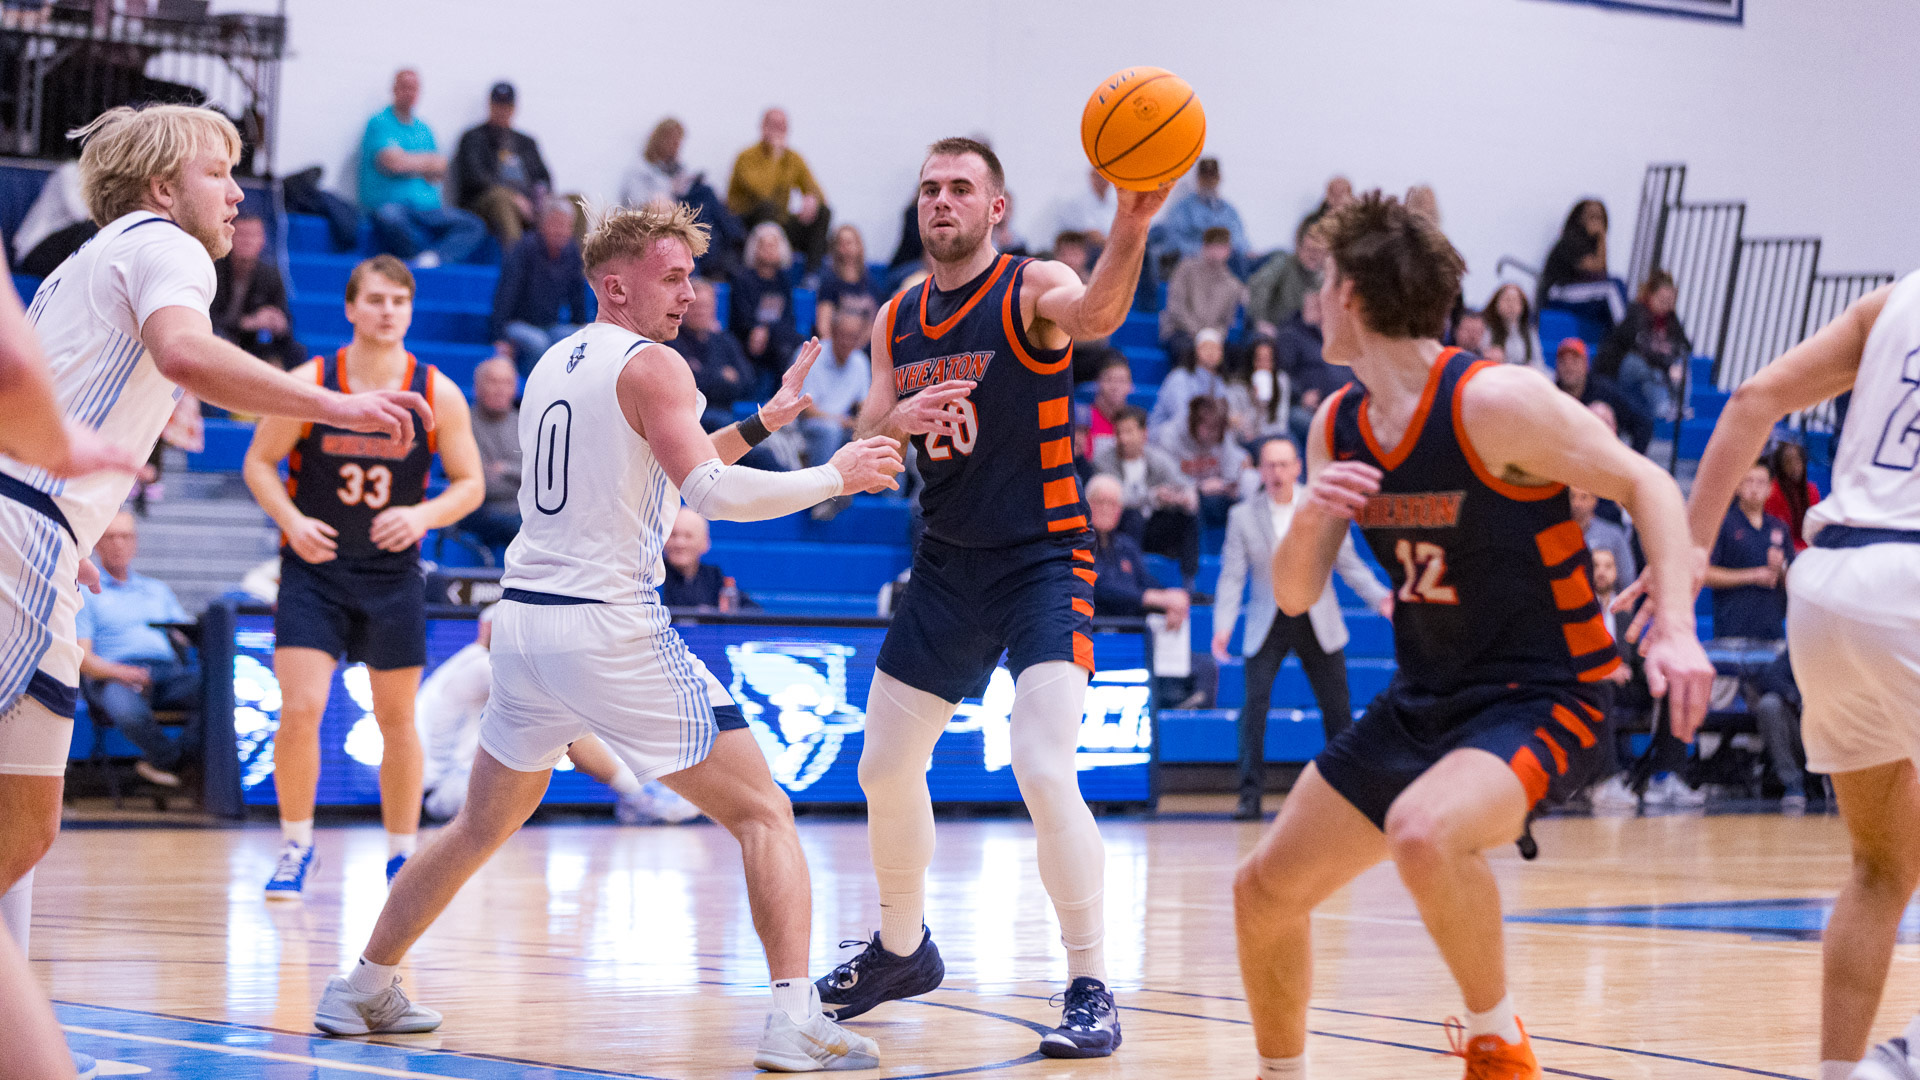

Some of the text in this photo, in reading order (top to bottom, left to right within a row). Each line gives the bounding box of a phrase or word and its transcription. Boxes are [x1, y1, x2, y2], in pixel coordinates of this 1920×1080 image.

[894, 350, 996, 396] WHEATON
[336, 462, 393, 509] 33
[535, 399, 572, 515] 0
[1395, 538, 1460, 606] 12
